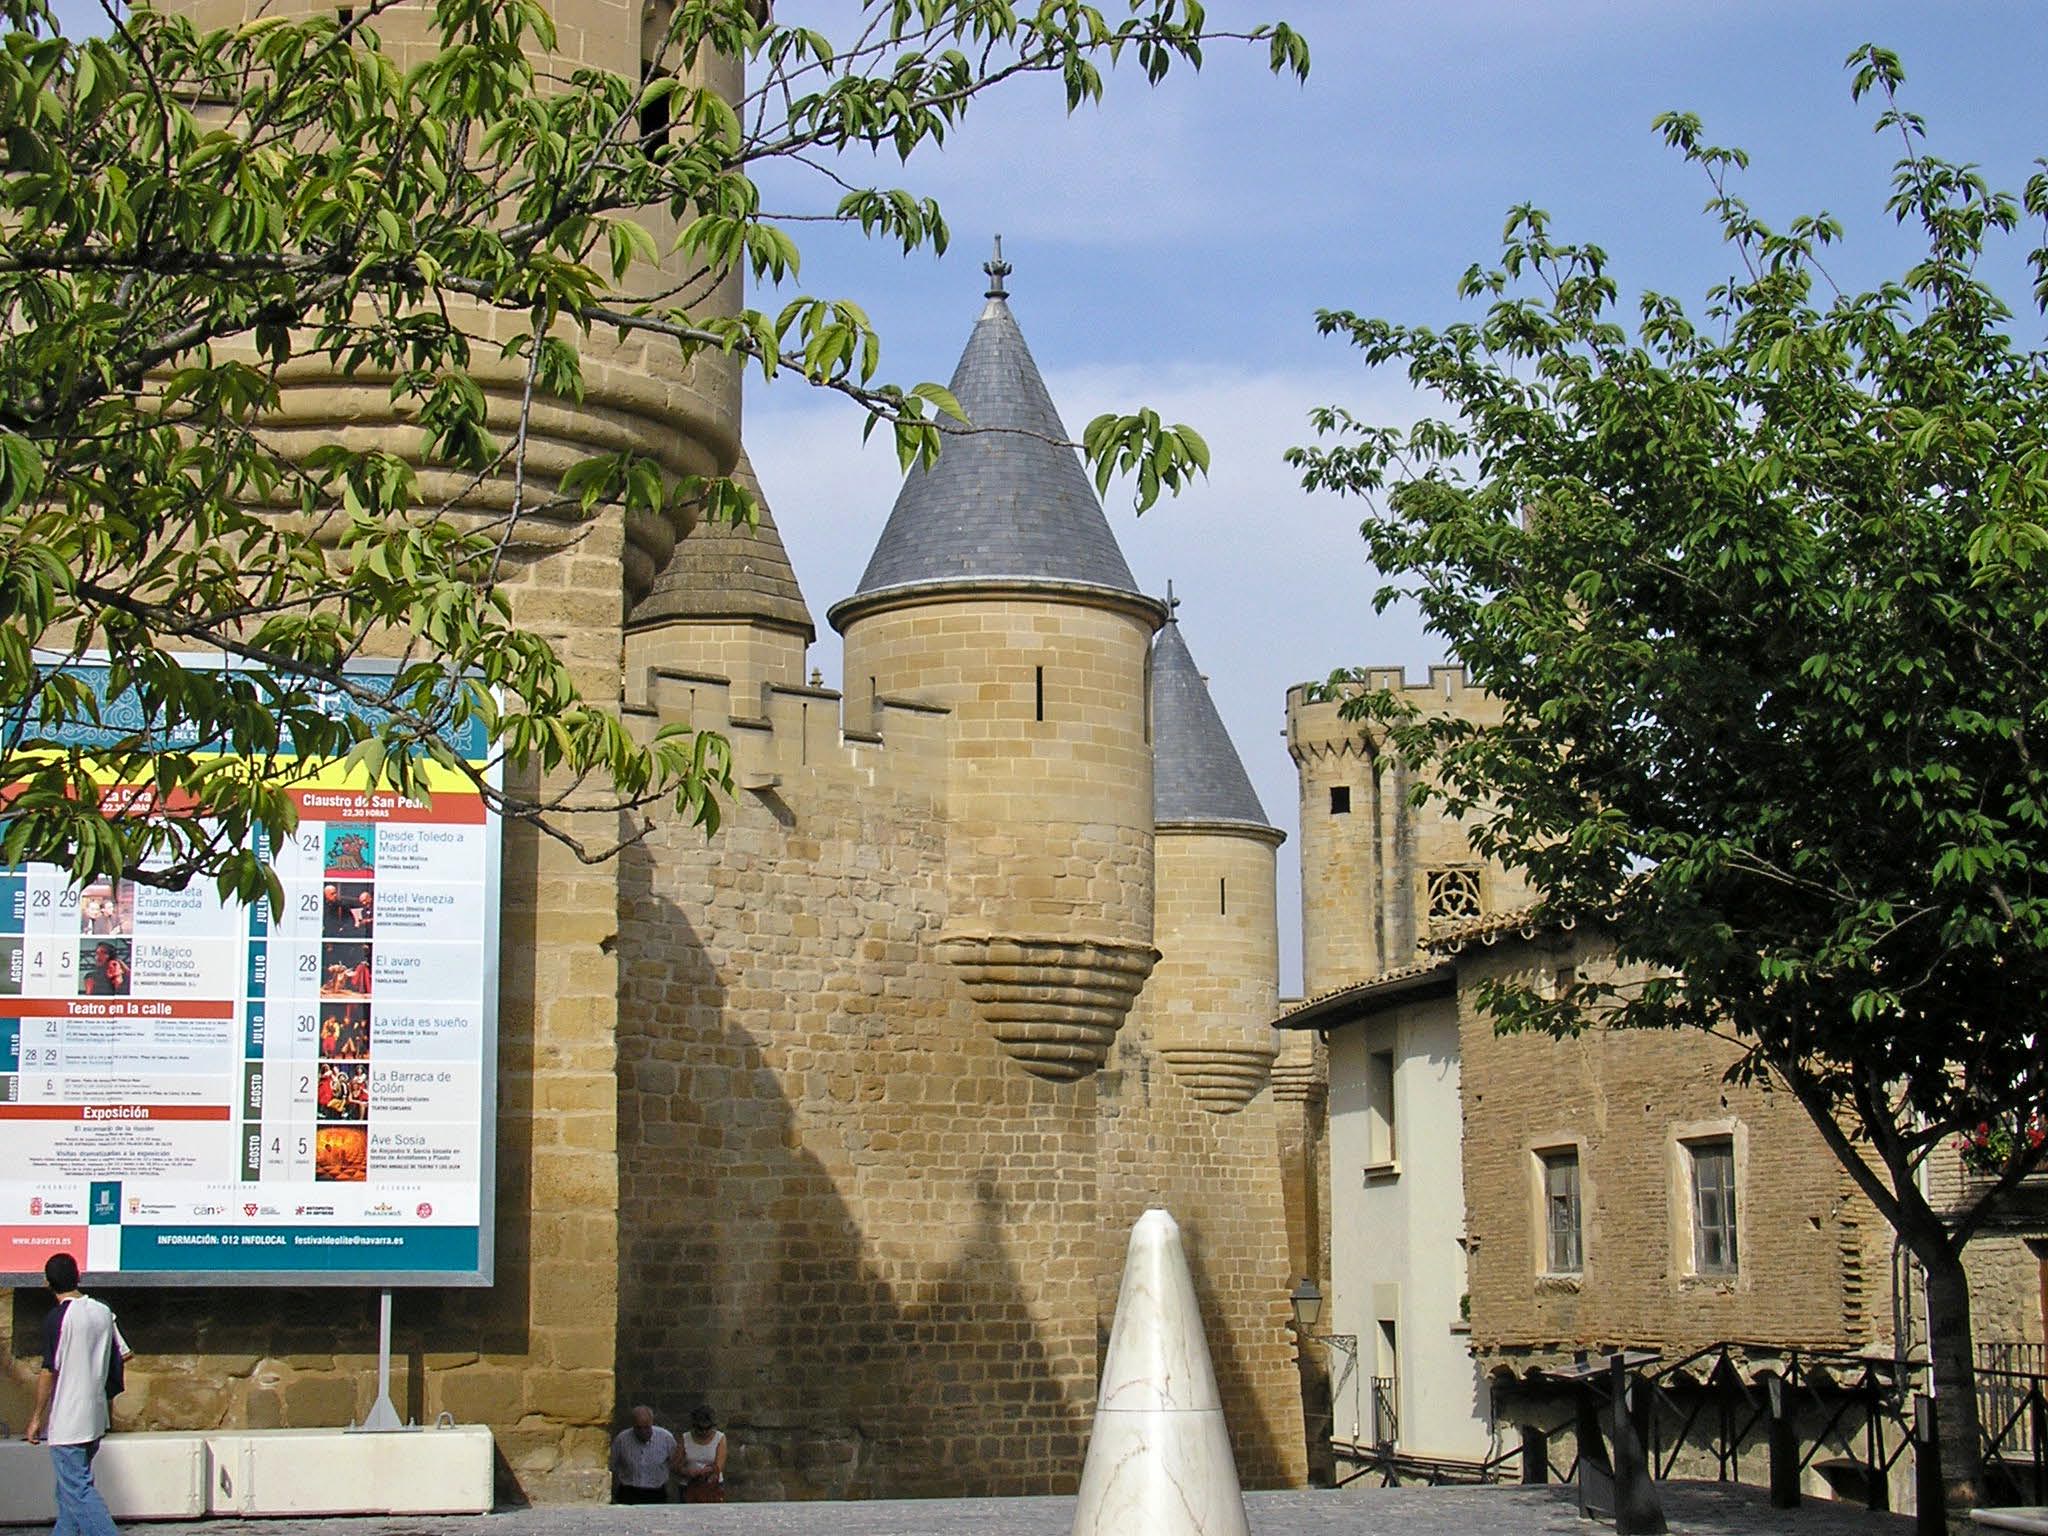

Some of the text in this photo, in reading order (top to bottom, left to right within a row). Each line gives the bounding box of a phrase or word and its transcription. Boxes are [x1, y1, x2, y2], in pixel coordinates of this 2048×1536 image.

[302, 793, 352, 808] Claustro
[372, 796, 395, 809] San
[342, 808, 390, 818] 22.30 HORAS
[302, 834, 320, 852] 24
[378, 830, 464, 843] Desde Toledo a
[379, 842, 418, 853] Madrid
[13, 890, 26, 920] JULIO
[32, 890, 77, 909] 28 29
[138, 896, 202, 908] Enamorada
[300, 894, 319, 912] 26
[378, 892, 455, 904] Hotel Venezia
[136, 945, 192, 960] El Mágico
[11, 948, 24, 984] AGOSTO
[34, 952, 70, 969] 4 5
[134, 957, 196, 970] Prodigioso
[299, 954, 318, 972] 28
[376, 955, 421, 968] El avaro
[254, 954, 266, 984] JULIO
[67, 1002, 173, 1016] Teatro en la calle
[46, 1021, 57, 1032] 21
[297, 1016, 316, 1033] 30
[374, 1016, 468, 1028] La vida es sueño
[252, 1016, 264, 1044] JULIO
[25, 1050, 37, 1061] 28
[45, 1050, 57, 1061] 29
[373, 1071, 452, 1082] La Barraca de
[46, 1079, 53, 1090] 6
[251, 1074, 262, 1108] AGOSTO
[299, 1076, 310, 1094] 2
[372, 1082, 404, 1094] Colón
[82, 1106, 150, 1121] Exposición
[272, 1138, 308, 1155] 4 5
[370, 1134, 426, 1146] Ave Sosia
[248, 1135, 261, 1170] AGOSTO
[12, 1236, 72, 1245] www.navarra.es
[158, 1234, 220, 1245] INFORMACIÓN:
[241, 1236, 287, 1245] INFOLOCAL
[294, 1234, 404, 1246] festivaldeolite@navarra.es
